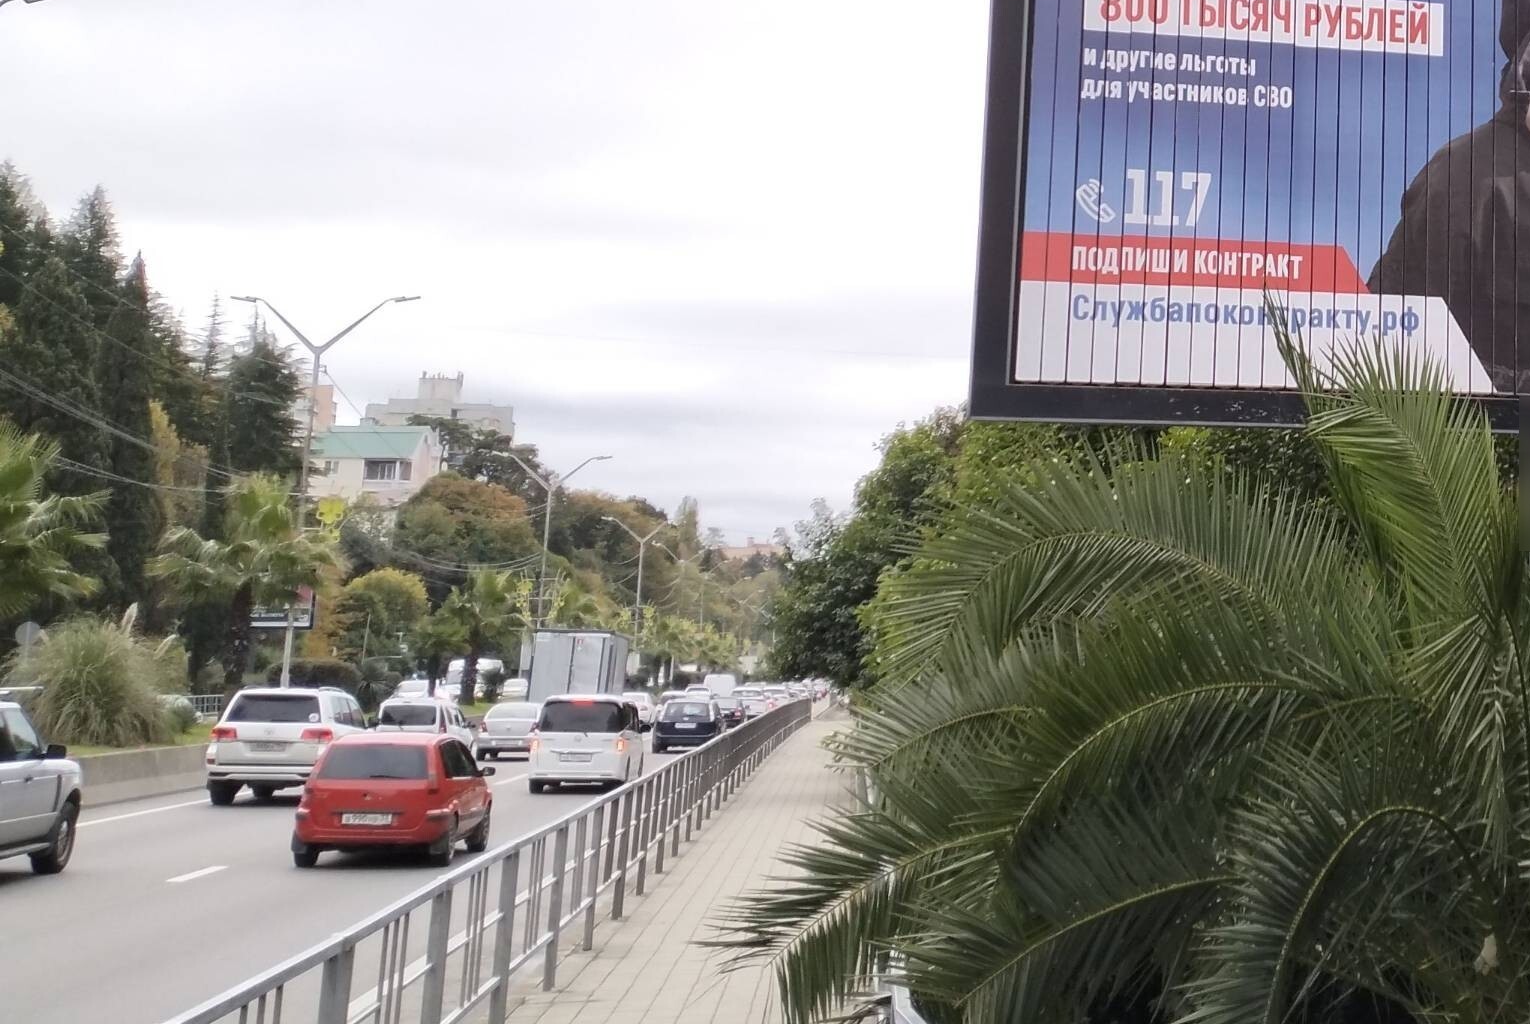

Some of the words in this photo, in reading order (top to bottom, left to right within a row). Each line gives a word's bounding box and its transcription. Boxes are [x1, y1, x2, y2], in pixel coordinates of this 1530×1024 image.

[1303, 1, 1429, 46] РУБЛЕЙ
[1084, 47, 1097, 67] и
[1100, 49, 1176, 73] другие
[1179, 53, 1256, 77] льготы
[1080, 78, 1122, 99] для
[1126, 81, 1249, 106] участников
[1253, 85, 1293, 108] СВО
[1124, 168, 1213, 228] 117
[1071, 245, 1188, 275] ПОДПИШИ
[1194, 249, 1303, 280] КОНТРАКТ
